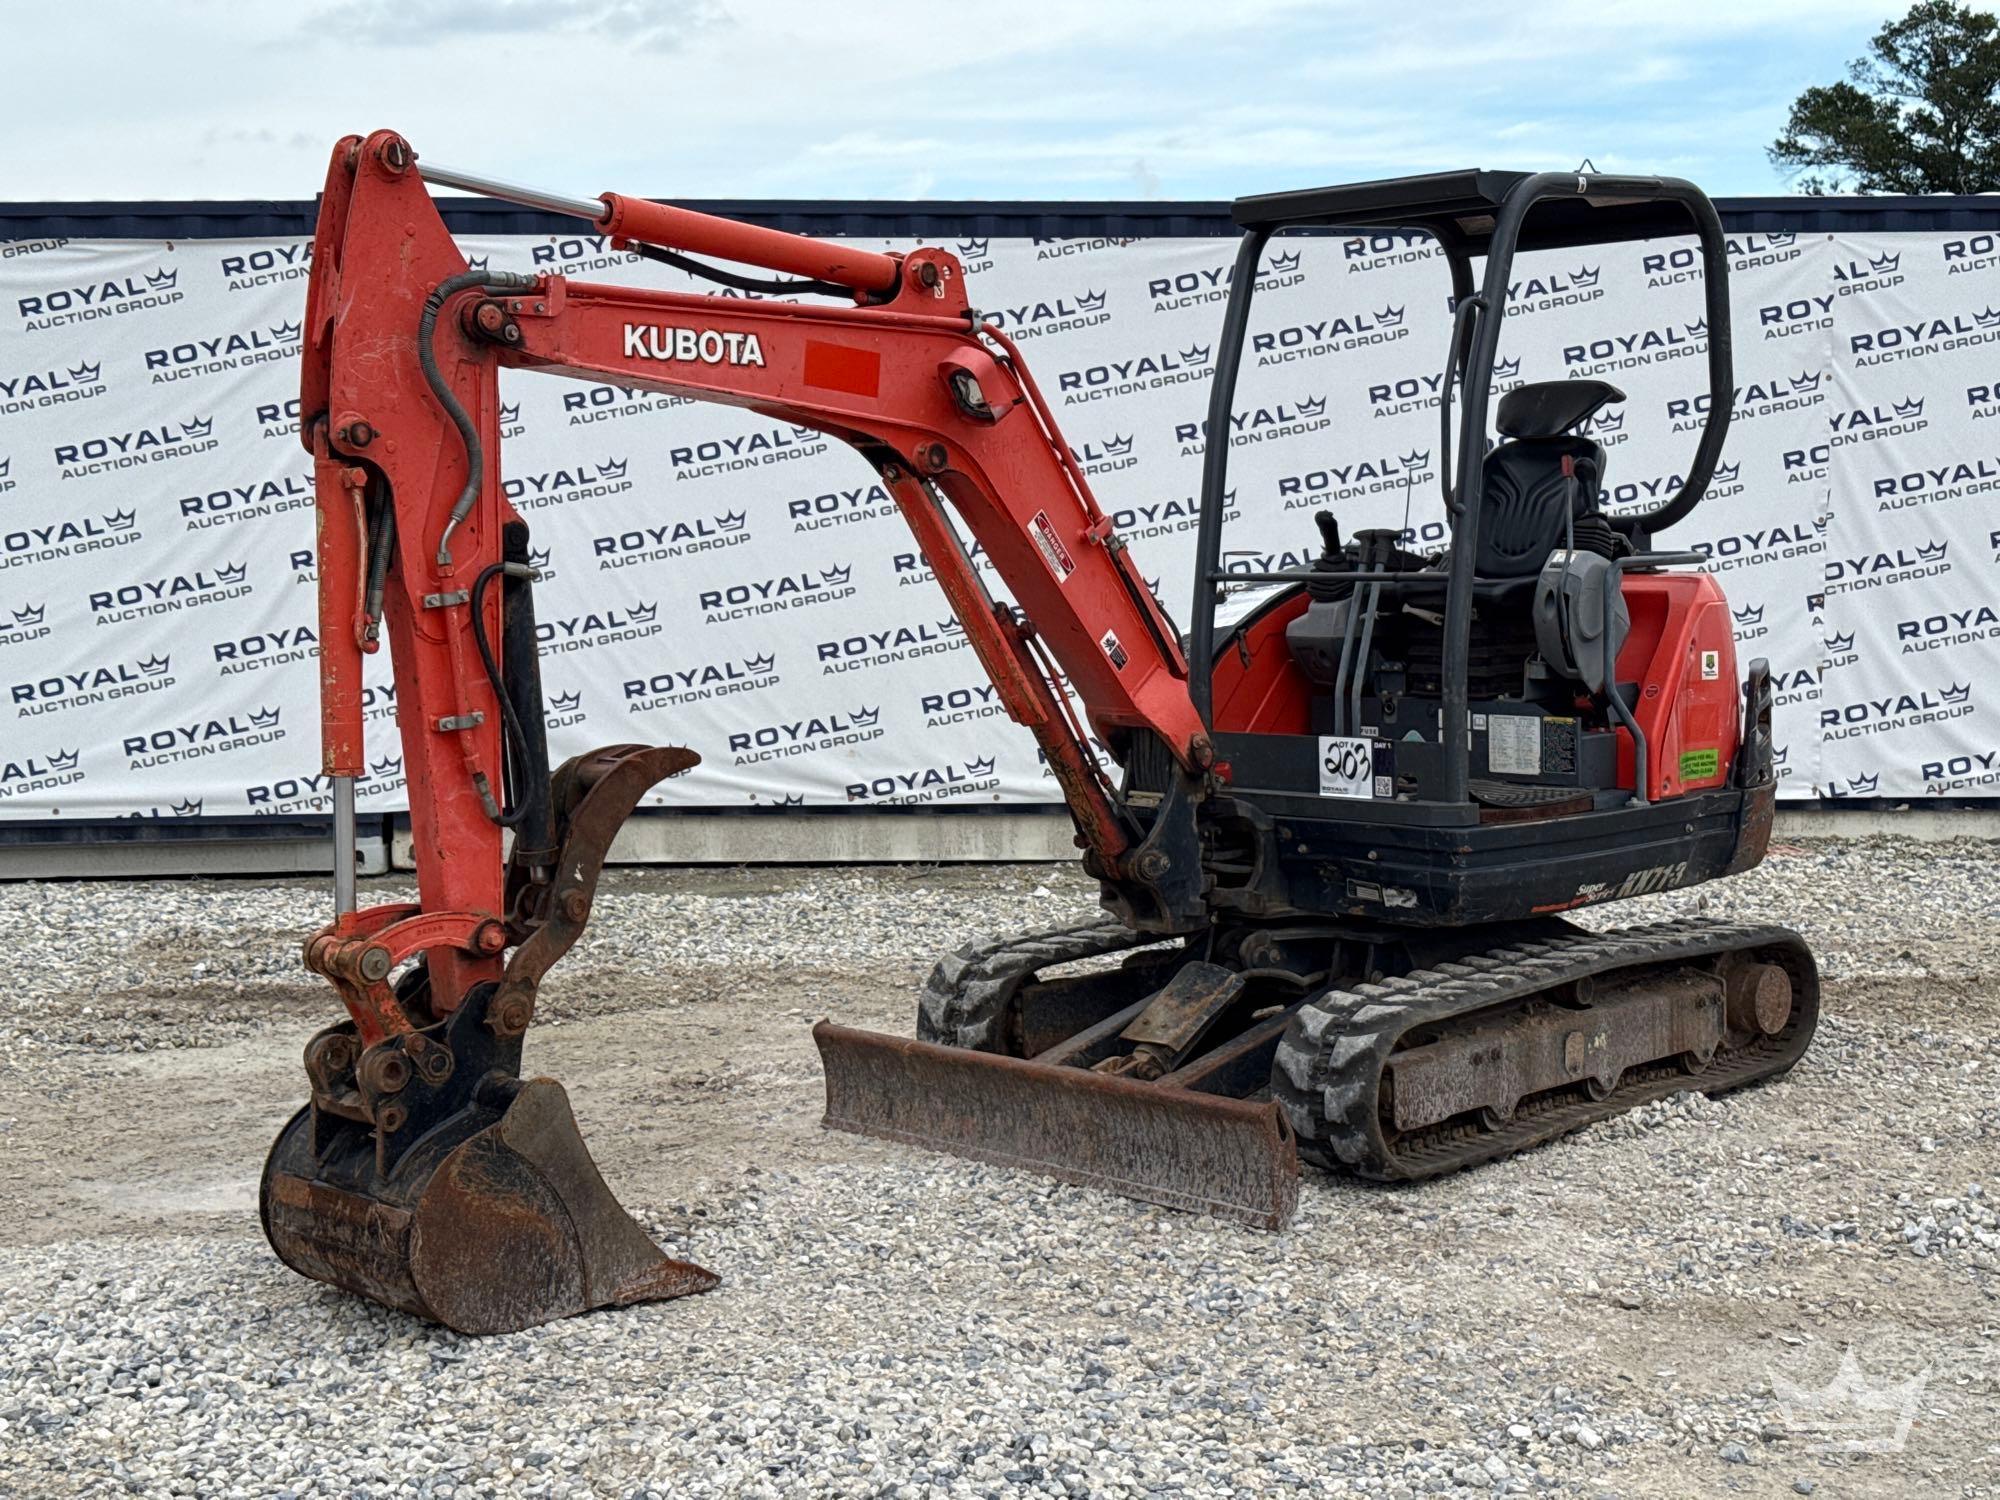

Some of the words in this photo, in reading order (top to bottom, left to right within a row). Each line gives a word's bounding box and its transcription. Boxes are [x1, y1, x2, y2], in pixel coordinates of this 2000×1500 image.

[2, 238, 69, 258] GROUP
[221, 242, 315, 277] ROY
[532, 236, 608, 265] ROY
[1037, 236, 1119, 261] AUCTION
[1349, 249, 1431, 274] AUCTION
[1735, 249, 1801, 271] GROUP
[1948, 256, 2000, 275] AUCT
[18, 278, 147, 317] ROYAL
[1254, 274, 1305, 293] ROUP
[1539, 289, 1604, 310] GROUP
[1838, 275, 1904, 296] GROUP
[26, 306, 112, 332] AUCTION
[116, 292, 183, 314] GROUP
[981, 299, 1076, 329] OYAL
[1046, 313, 1111, 334] GROUP
[1760, 294, 1834, 326] ROY
[624, 323, 764, 366] KUBOTA
[1252, 315, 1374, 353] ROYAL
[1765, 318, 1833, 340] AUCTIO
[1851, 316, 1973, 354] ROYAL
[145, 331, 271, 370] ROYAL
[1258, 342, 1340, 367] AUCTION
[1344, 329, 1409, 349] GROUP
[1563, 327, 1685, 365] ROYAL
[1569, 354, 1651, 379] AUCTION
[1655, 343, 1708, 362] GROU
[1855, 343, 1939, 368] AUCTION
[1943, 331, 2000, 350] GROU
[0, 371, 70, 398] YAL
[152, 359, 237, 384] AUCTION
[1059, 354, 1180, 391] ROYAL
[1065, 381, 1146, 405] AUCTION
[1150, 368, 1214, 388] GROUP
[1369, 372, 1447, 404] ROY
[1489, 380, 1525, 396] OUP
[38, 385, 106, 407] GROUP
[563, 386, 649, 412] ROY
[570, 402, 652, 426] AUCTION
[1175, 405, 1296, 443] RYAL
[1672, 408, 1754, 433] AUCON
[1759, 394, 1824, 415] GROUP
[1829, 406, 1893, 432] YAL
[54, 426, 182, 465] ROYAL
[1181, 432, 1262, 457] AUION
[1266, 419, 1330, 440] GROUP
[1862, 420, 1928, 441] GROUP
[62, 454, 147, 480] AUCTION
[151, 440, 218, 461] GROUP
[670, 430, 792, 467] ROYAL
[677, 457, 758, 481] AUCTION
[762, 444, 827, 464] GROUP
[501, 467, 597, 498] OYAL
[567, 481, 632, 501] GROUP
[1279, 459, 1400, 496] ROYAL
[1284, 486, 1365, 510] AUCTION
[1370, 472, 1434, 493] GROUP
[1599, 475, 1685, 505] ROYA
[1702, 485, 1745, 501] OUP
[1874, 460, 1996, 498] ROYAL
[179, 477, 305, 517] ROYAL
[187, 505, 271, 531] AUCTION
[275, 495, 316, 512] GRO
[788, 485, 889, 519] ROYA
[1113, 497, 1200, 529] OYAL
[1879, 487, 1962, 512] AUCTION
[4, 519, 105, 552] OYAL
[593, 519, 716, 556] ROYAL
[794, 509, 876, 533] AUCTION
[1118, 524, 1174, 544] CTION
[1177, 511, 1242, 532] GRUP
[0, 546, 70, 569] UCTION
[74, 532, 142, 554] GROUP
[600, 546, 682, 570] AUCTION
[686, 533, 751, 553] GROUP
[1043, 527, 1065, 560] DANGER
[1691, 524, 1814, 559] ROYAL
[1227, 548, 1318, 574] OYAL
[1697, 551, 1779, 573] AUCTION
[1824, 550, 1917, 582] OYAL
[89, 572, 216, 612] ROYAL
[699, 574, 821, 610] ROYAL
[1824, 576, 1883, 596] CTION
[1886, 563, 1951, 584] GROUP
[96, 600, 182, 626] AUCTION
[186, 585, 252, 607] GROUP
[706, 600, 787, 624] AUCTION
[791, 587, 856, 607] GROUP
[0, 627, 51, 646] ROUP
[535, 611, 627, 642] OYAL
[1734, 626, 1769, 641] OUP
[1897, 607, 1998, 640] ROYA
[213, 626, 317, 662] ROYA
[537, 638, 593, 656] CTION
[597, 625, 662, 645] GROUP
[817, 624, 938, 661] ROYAL
[823, 651, 904, 675] AUCTION
[908, 638, 971, 658] GROUP
[1902, 630, 1985, 654] AUCTION
[220, 650, 305, 676] AUCTION
[1823, 654, 1860, 669] OUP
[11, 664, 139, 704] ROYAL
[623, 662, 745, 699] ROYAL
[630, 689, 711, 713] AUCTION
[715, 676, 780, 696] GROUP
[18, 692, 104, 718] AUCTION
[108, 677, 175, 699] GROUP
[921, 685, 995, 714] ROY
[1821, 692, 1939, 728] ROYAL
[123, 717, 250, 757] ROYAL
[547, 714, 586, 729] OUP
[729, 715, 850, 752] ROYAL
[1823, 718, 1905, 742] AUCTION
[1909, 705, 1974, 725] GROUP
[130, 744, 215, 770] AUCTION
[219, 730, 285, 751] GROUP
[734, 742, 816, 767] AUCTION
[820, 729, 884, 749] GROUP
[1324, 742, 1371, 782] 203
[17, 772, 85, 793] GROUP
[1921, 751, 2000, 781] ROY
[1926, 771, 2000, 794] AUCTIO
[246, 774, 371, 805] ROY
[355, 779, 407, 798] ROUP
[845, 765, 966, 801] ROYAL
[936, 778, 1000, 799] GROUP
[1576, 882, 1607, 896] Super
